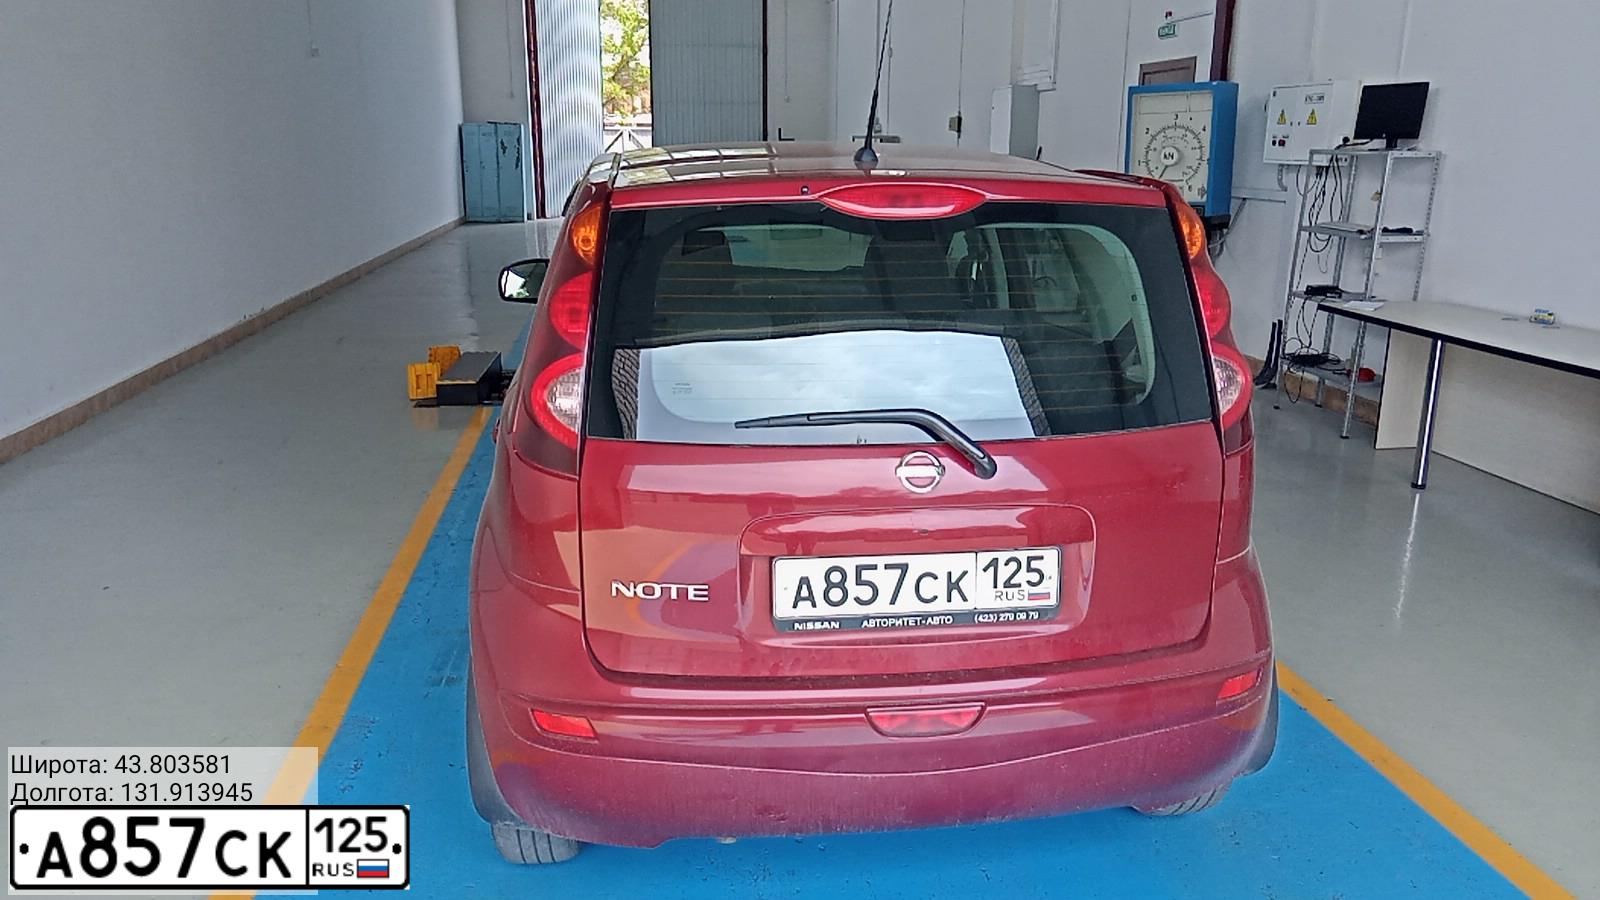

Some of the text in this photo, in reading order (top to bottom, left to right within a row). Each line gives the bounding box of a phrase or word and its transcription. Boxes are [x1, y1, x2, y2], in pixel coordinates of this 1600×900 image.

[792, 555, 1046, 609] А857СК 125
[611, 581, 709, 601] NOTE
[994, 589, 1026, 601] RUS
[861, 615, 953, 629] АВТОРИТЕТ-АВТО
[974, 613, 997, 624] (423)
[794, 621, 840, 630] NISSAN
